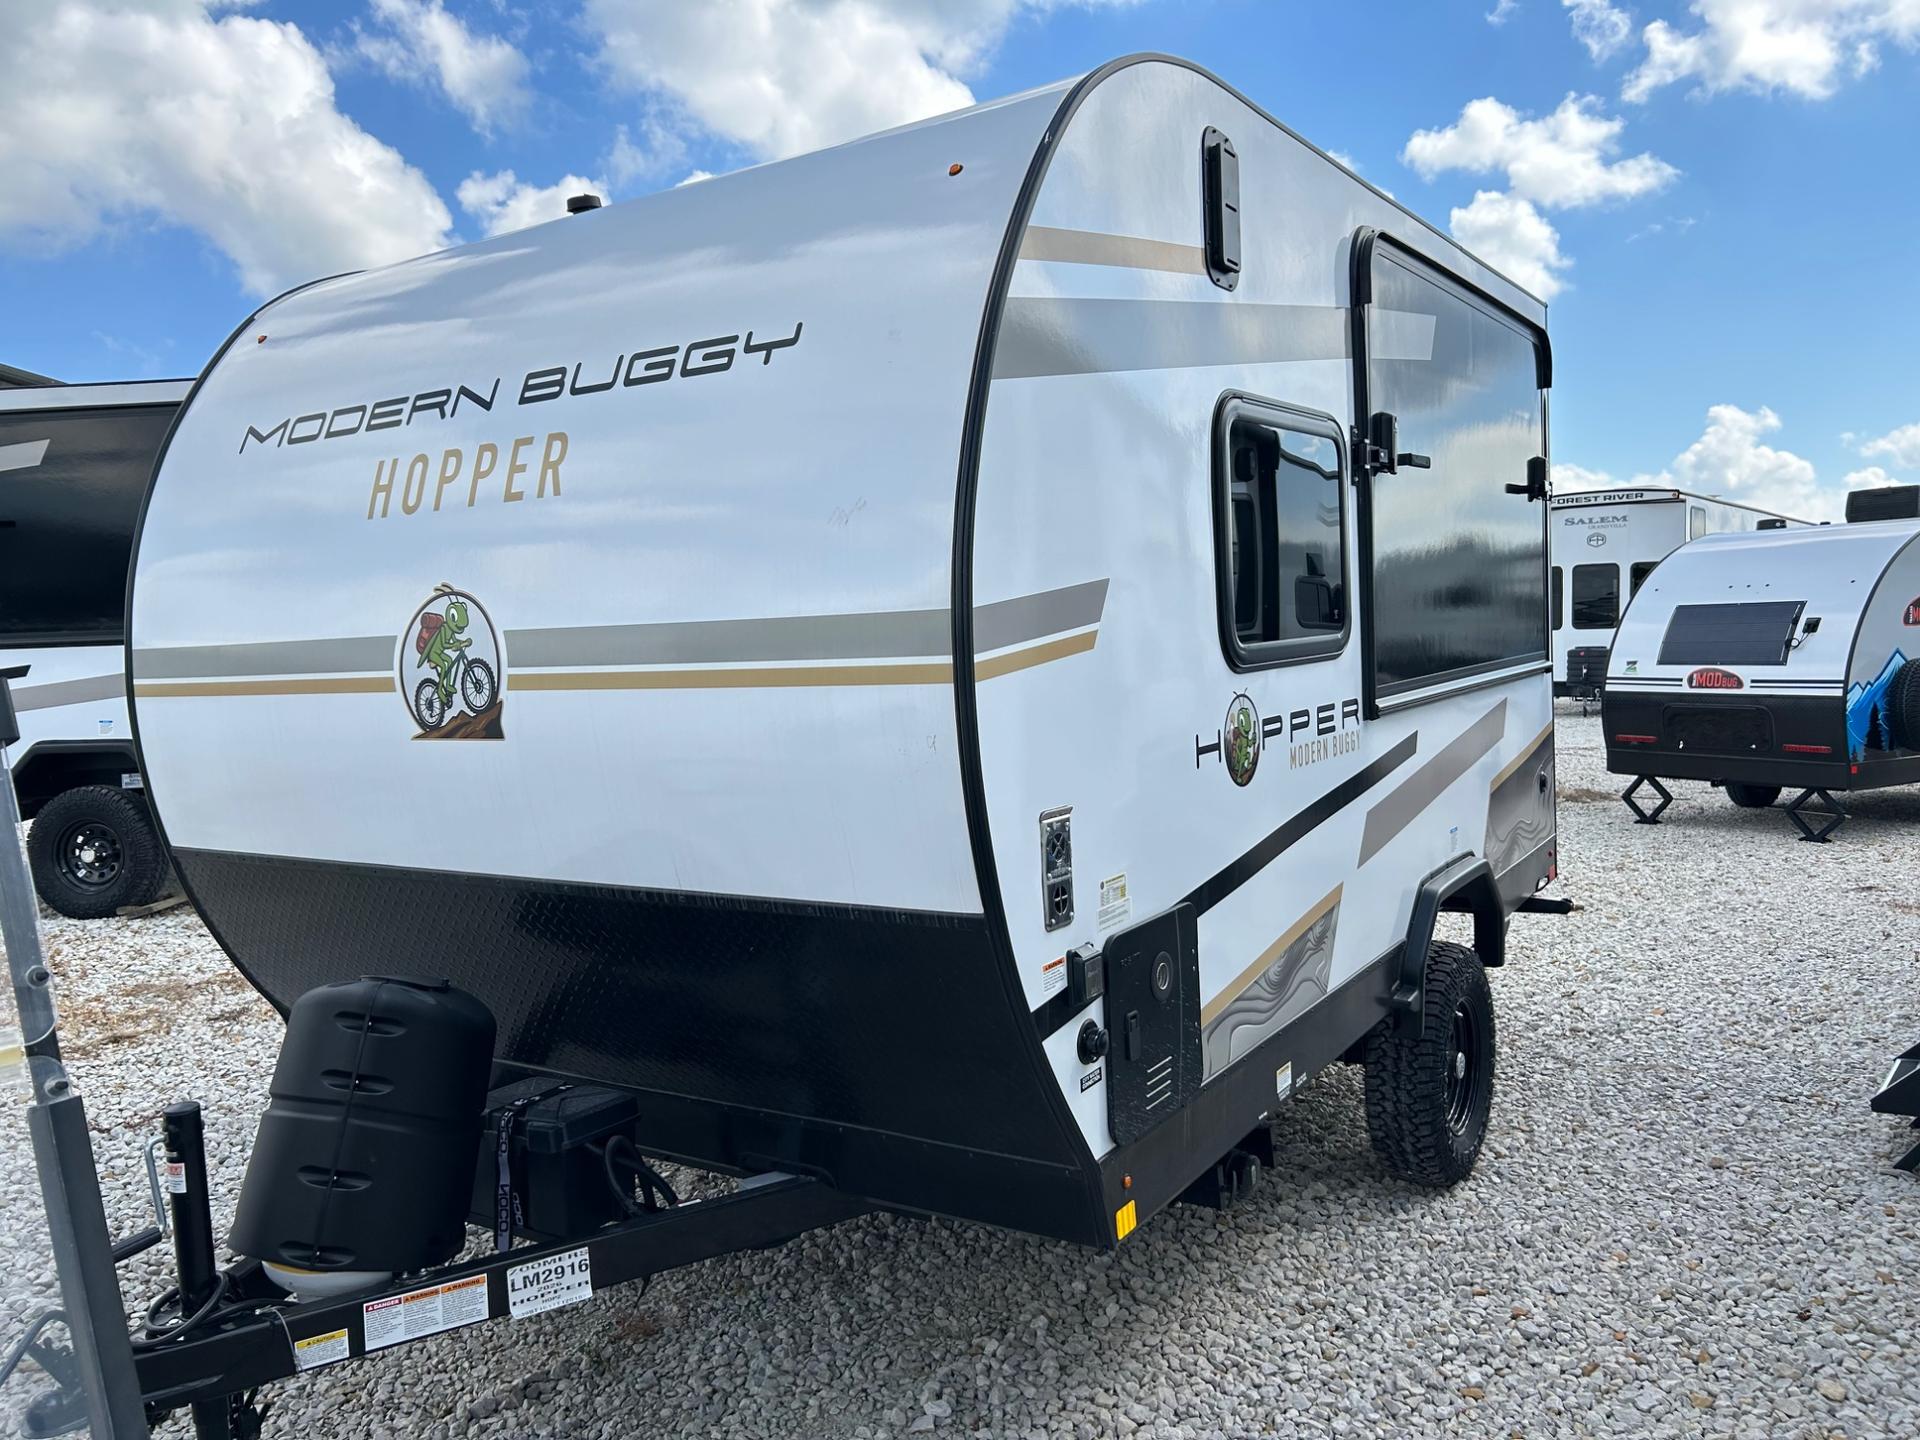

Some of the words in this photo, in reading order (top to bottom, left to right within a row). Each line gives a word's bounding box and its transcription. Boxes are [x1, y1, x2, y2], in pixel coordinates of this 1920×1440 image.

[239, 377, 500, 455] MODERN
[518, 321, 803, 405] BUGGY
[367, 431, 569, 520] HOPPER
[1603, 492, 1644, 502] RIVER
[1564, 515, 1628, 526] SALEM
[1290, 738, 1328, 770] MODERN
[1332, 729, 1361, 758] BUGGY
[511, 1258, 589, 1292] LM2916
[373, 1299, 400, 1310] DANGER
